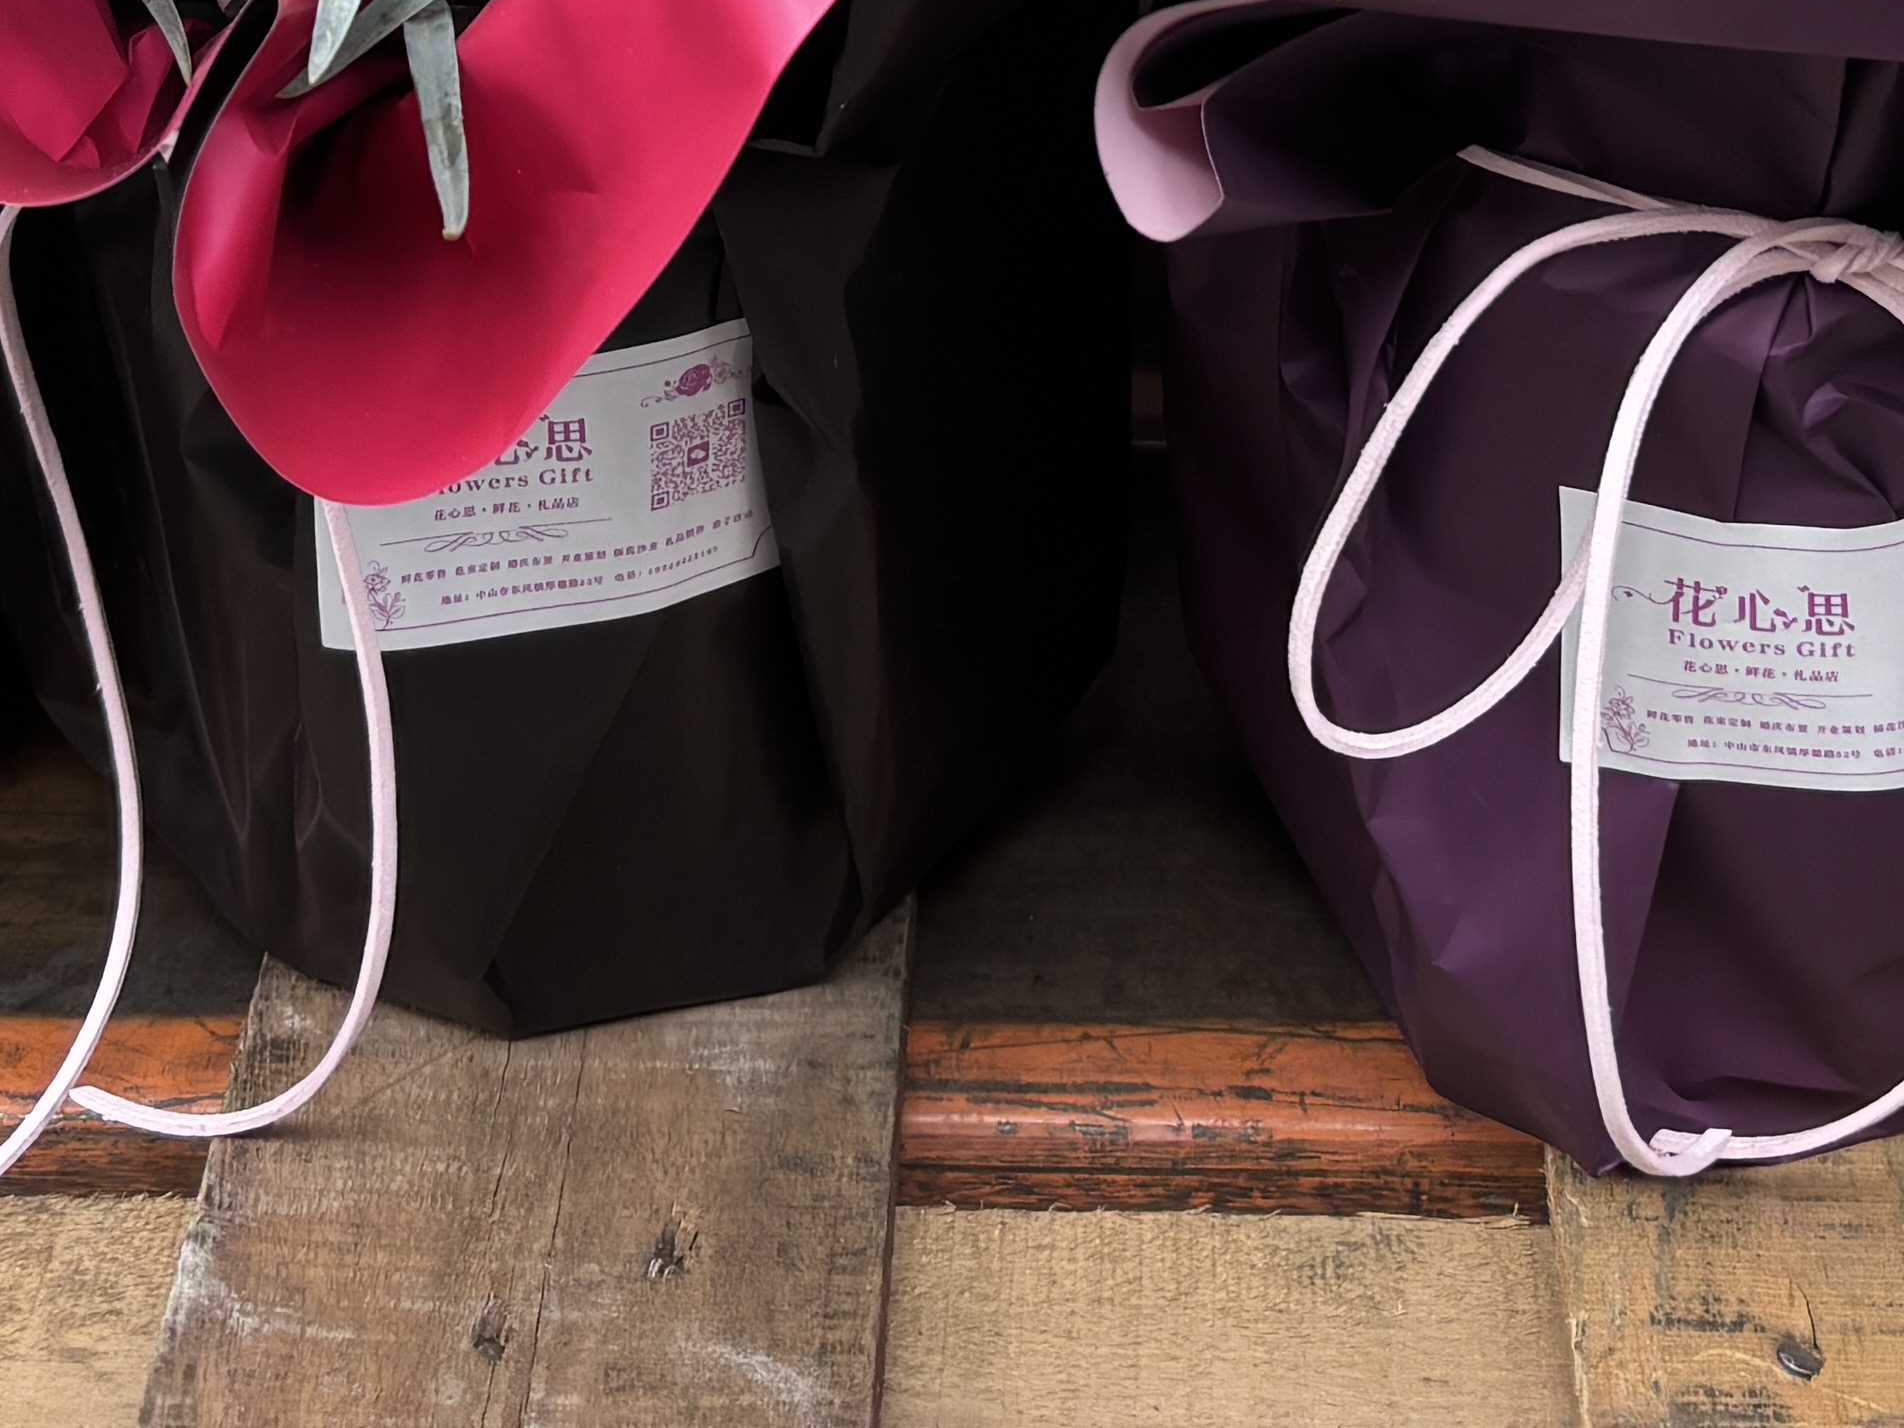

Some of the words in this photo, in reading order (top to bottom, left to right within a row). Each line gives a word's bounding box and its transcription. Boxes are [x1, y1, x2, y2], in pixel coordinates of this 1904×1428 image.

[539, 468, 593, 485] Gift
[1665, 577, 1855, 636] 花心思
[1668, 628, 1785, 656] Flowers
[1797, 641, 1856, 658] Gift
